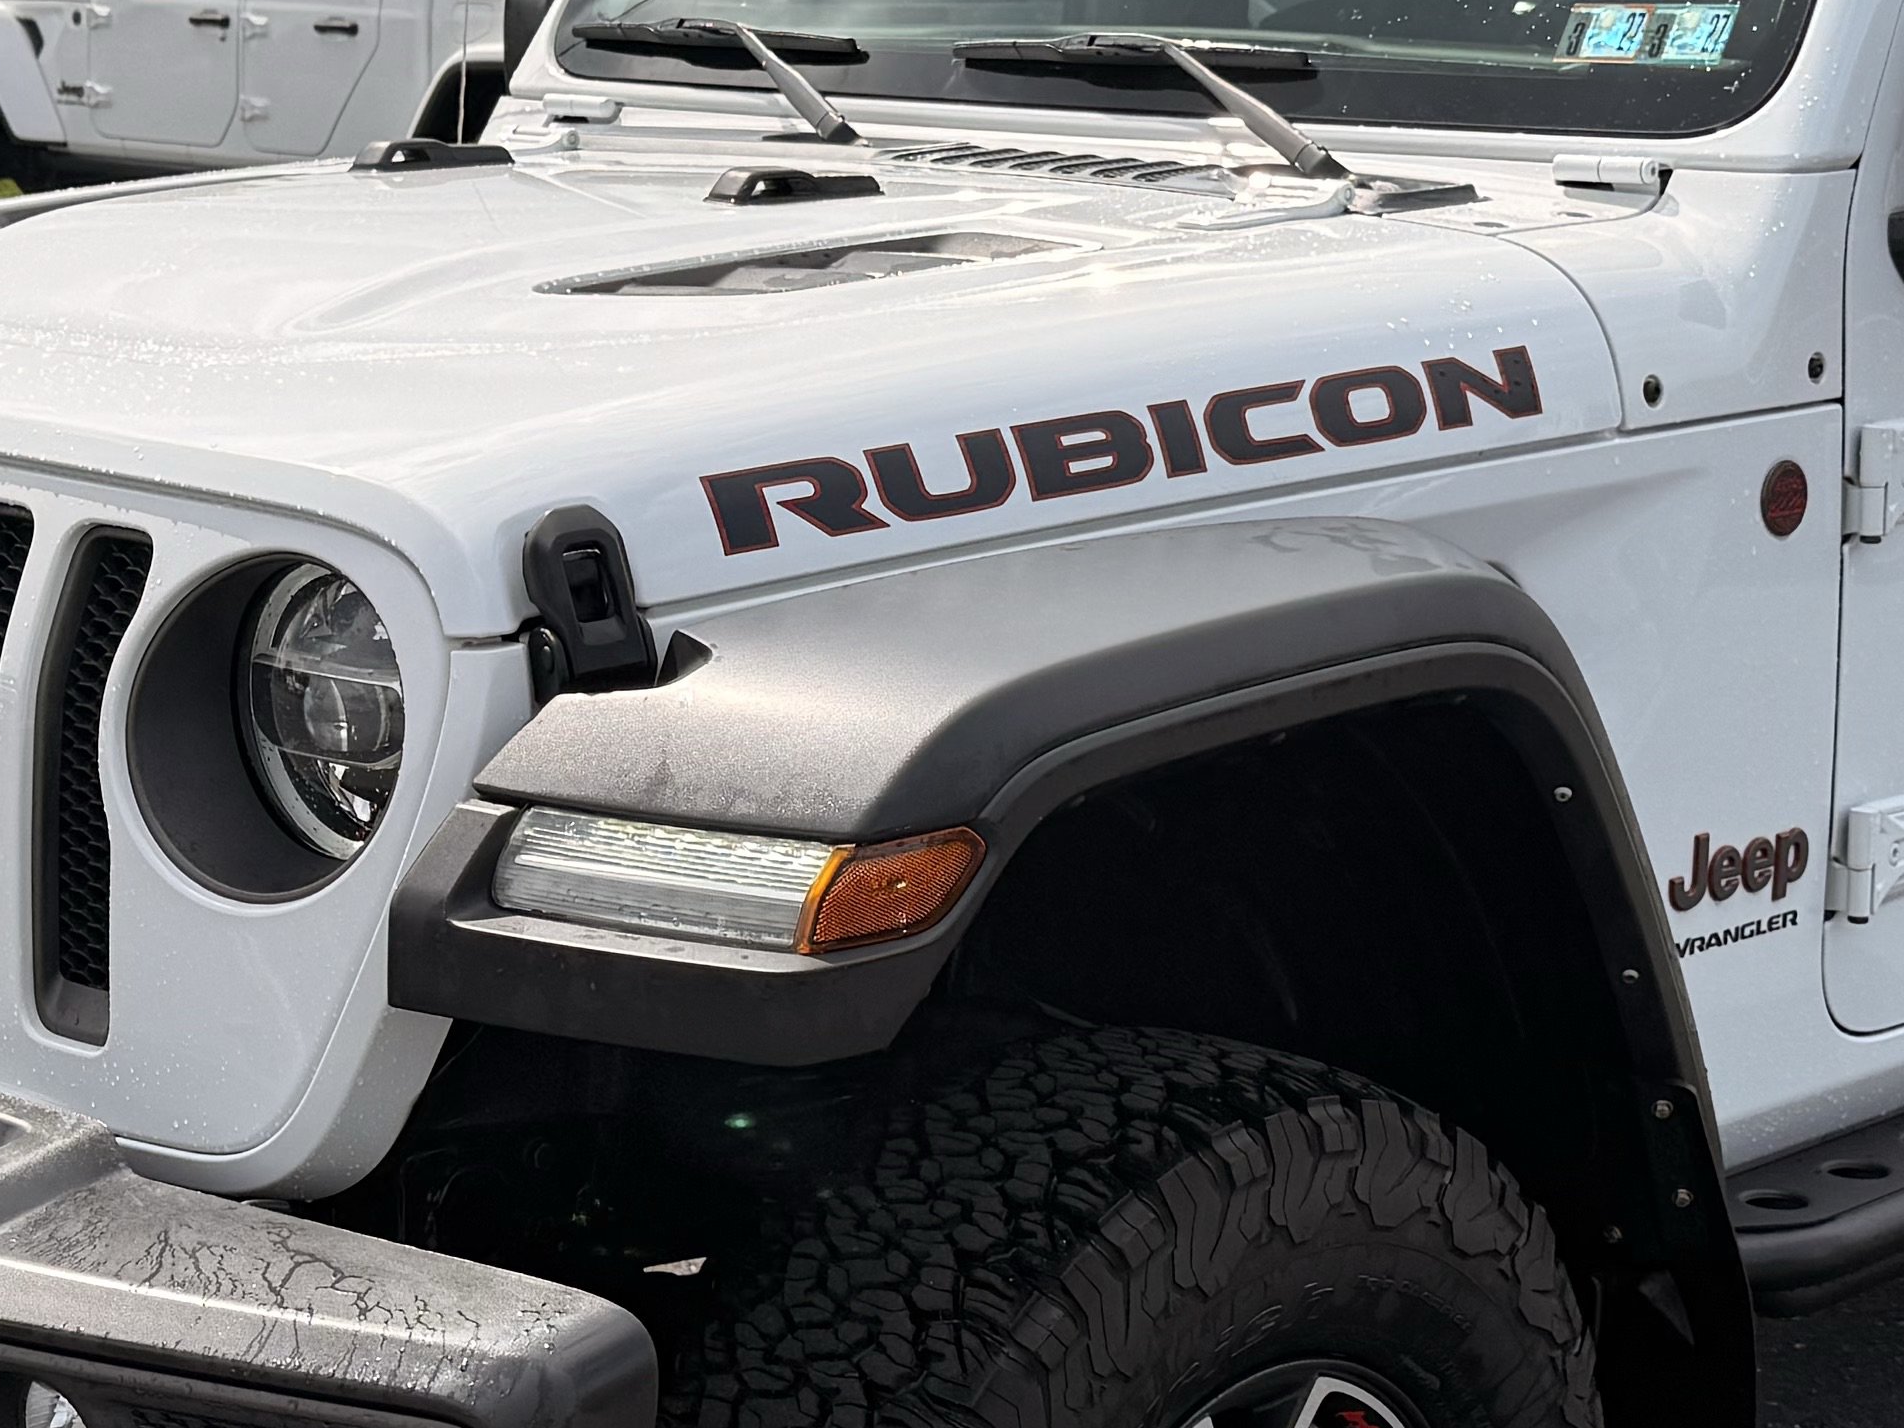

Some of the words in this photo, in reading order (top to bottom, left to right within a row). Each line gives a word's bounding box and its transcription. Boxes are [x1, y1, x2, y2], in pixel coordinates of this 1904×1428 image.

[1567, 22, 1586, 57] 3
[698, 345, 1545, 556] RUBICON
[1667, 826, 1810, 913] Jeep
